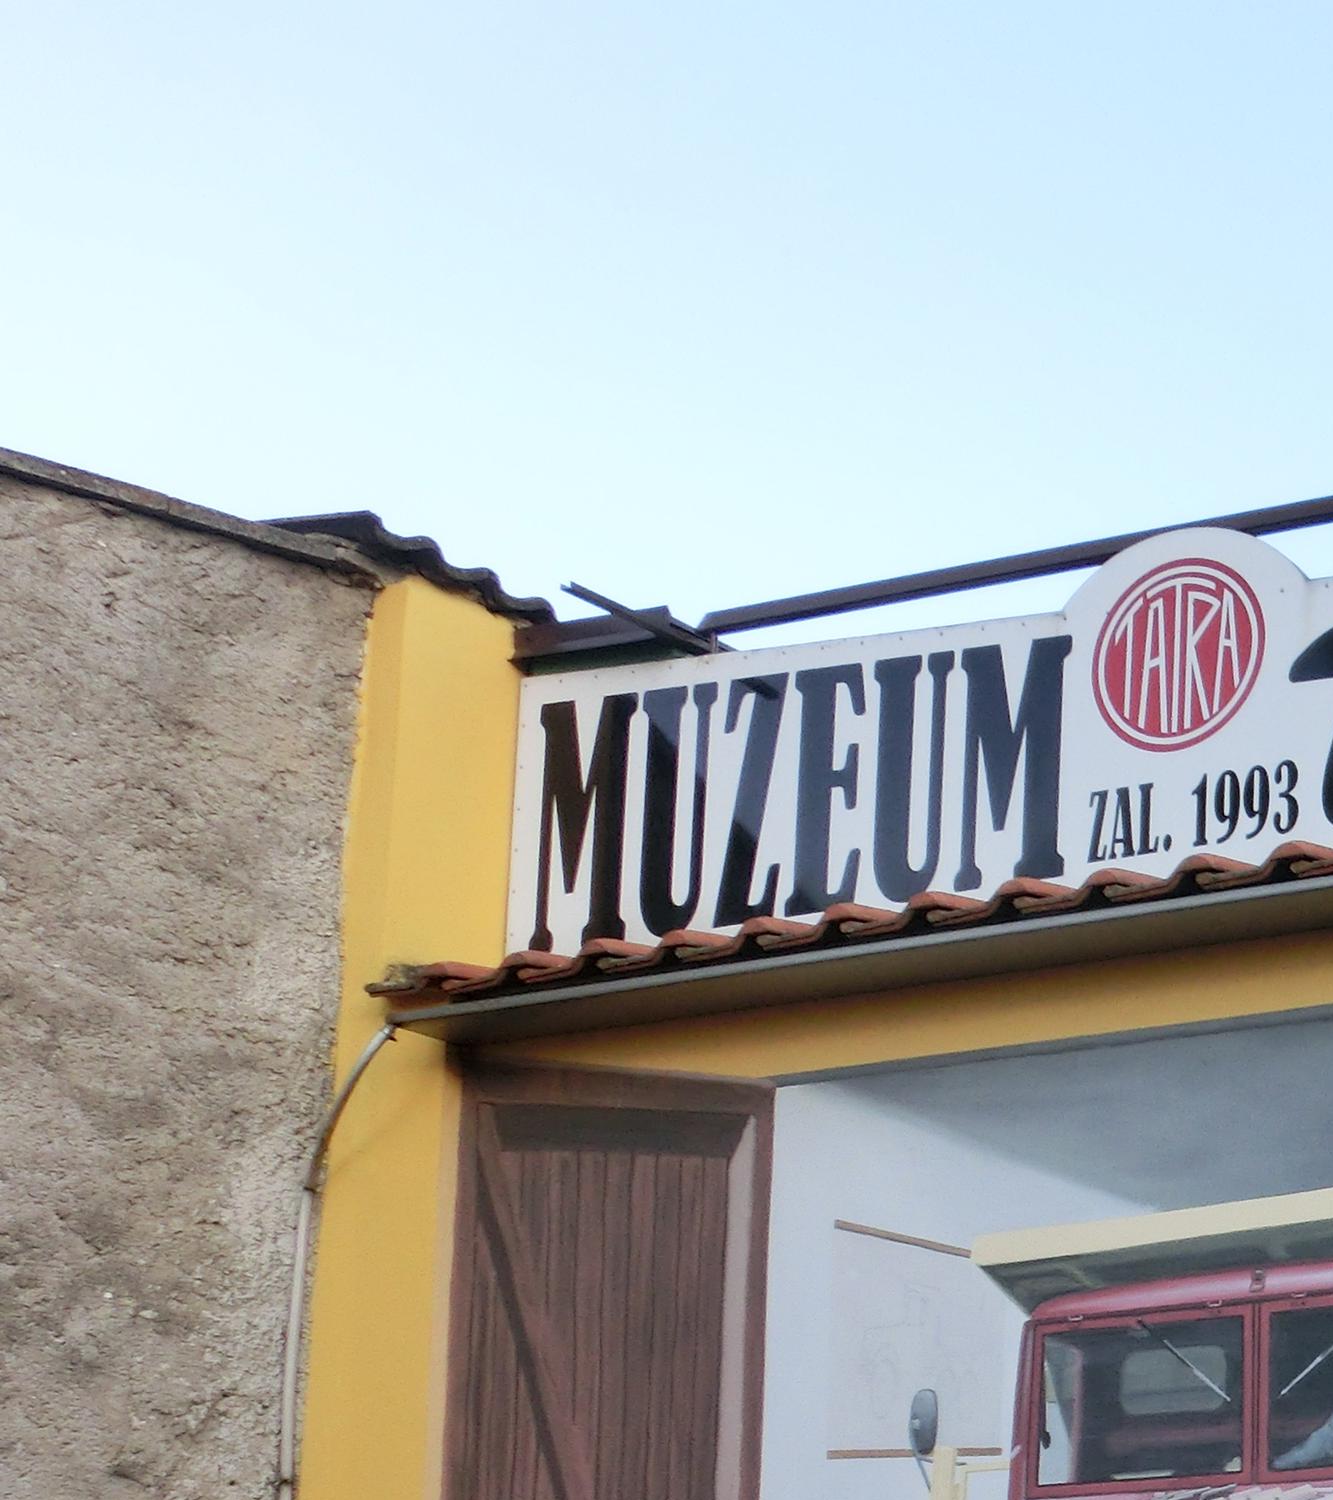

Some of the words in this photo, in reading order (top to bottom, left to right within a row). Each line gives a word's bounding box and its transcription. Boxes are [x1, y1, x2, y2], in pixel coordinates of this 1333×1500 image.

[1114, 577, 1240, 734] TATRA
[529, 635, 1071, 950] MUZEUM
[1087, 782, 1172, 863] ZAL.
[1191, 759, 1299, 847] 1993
